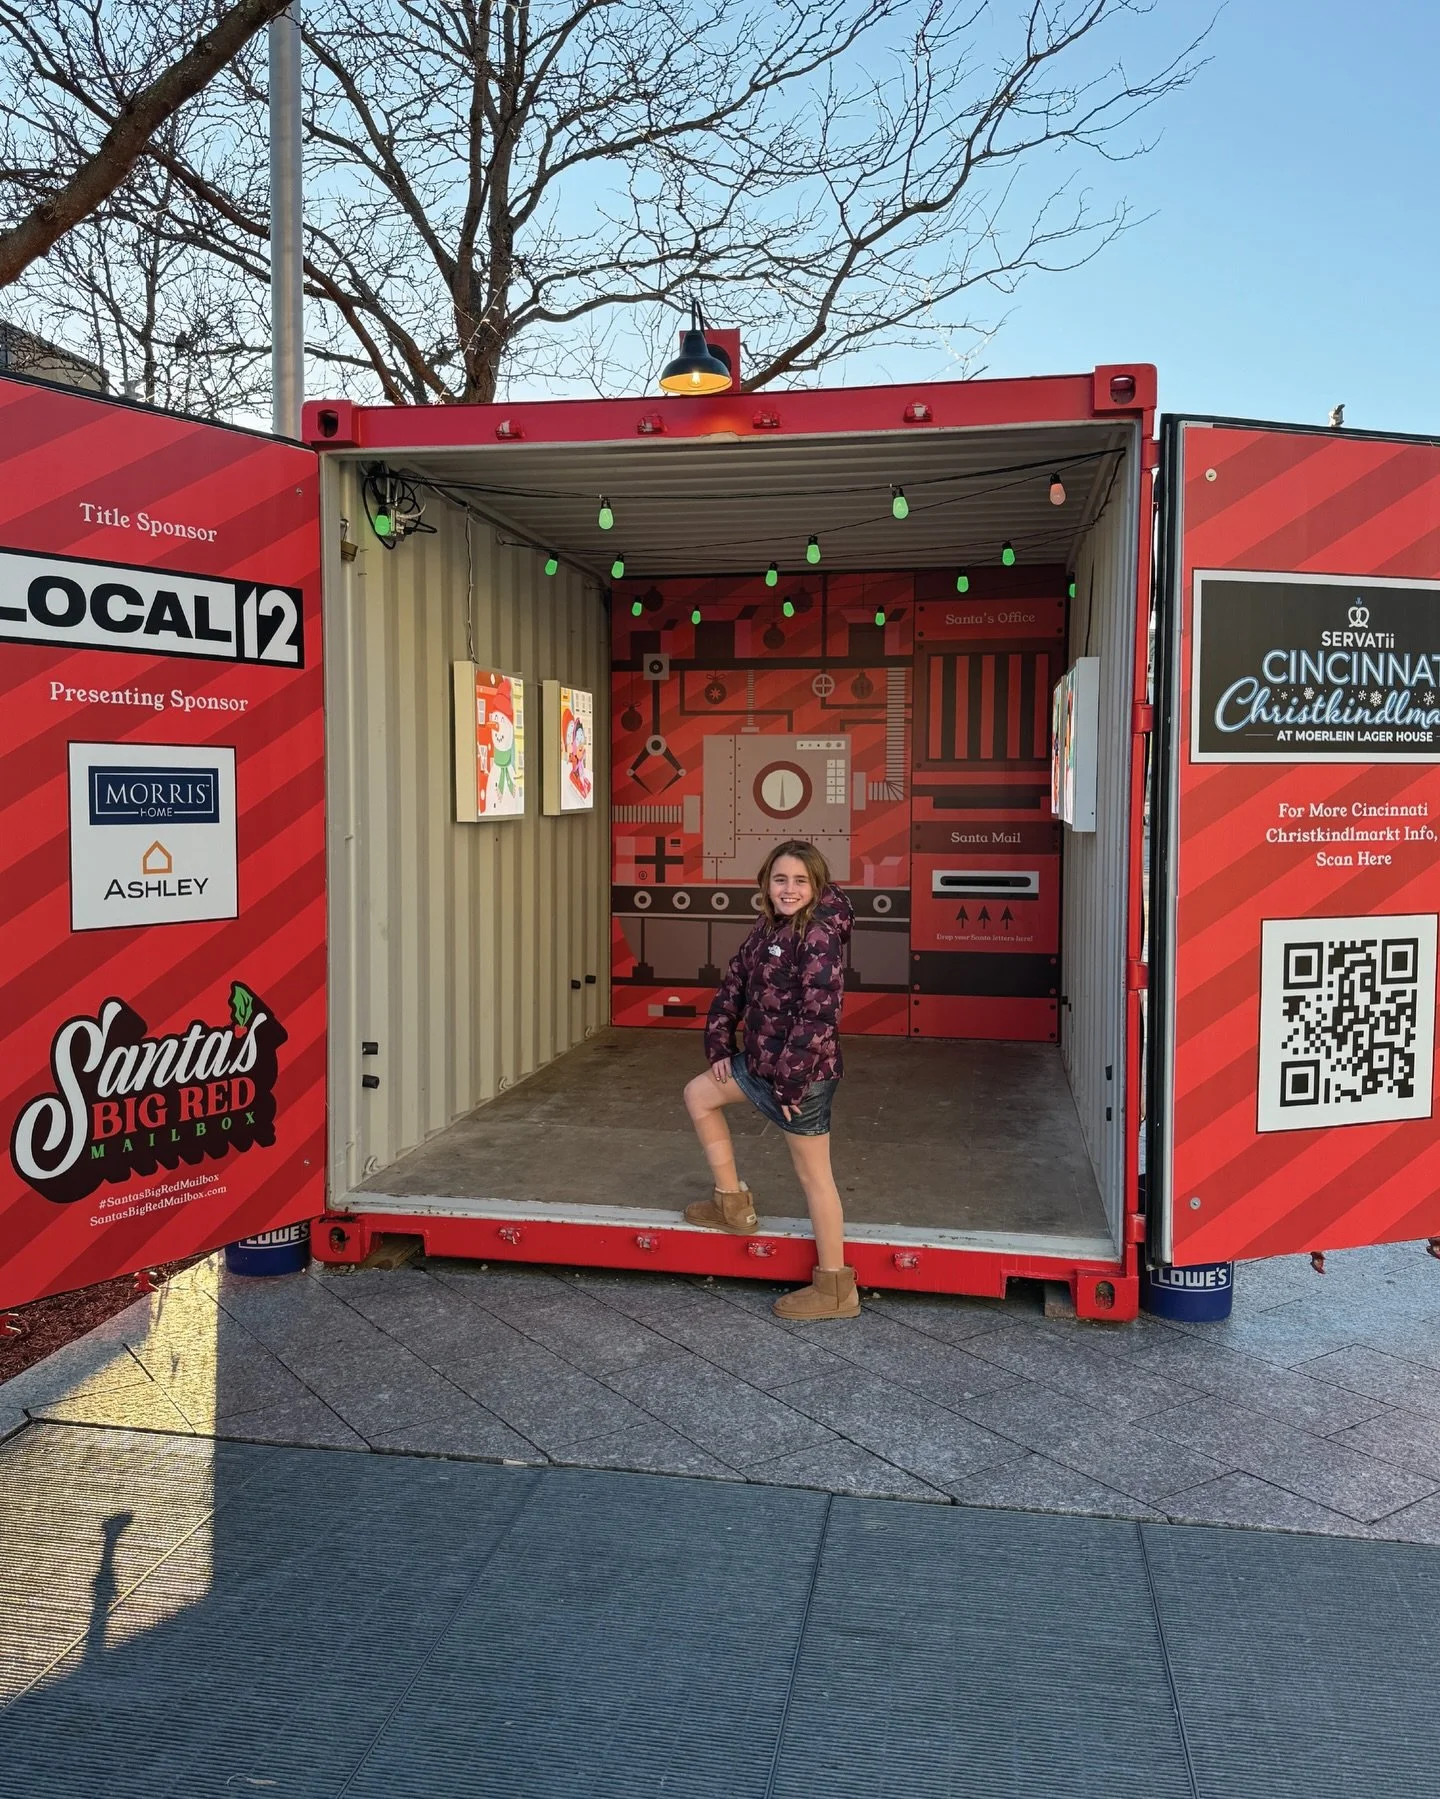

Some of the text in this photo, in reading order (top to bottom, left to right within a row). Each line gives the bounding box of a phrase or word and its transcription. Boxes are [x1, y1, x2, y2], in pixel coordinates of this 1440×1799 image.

[79, 502, 218, 542] Title Sponsor
[242, 586, 299, 663] 12
[945, 611, 1036, 626] Santa's Office
[1321, 631, 1395, 649] SERVATii
[50, 681, 249, 712] Presenting Sponsor
[1277, 730, 1434, 743] AT MOERLEIN LAGER HOUSE
[105, 783, 206, 805] MORRIS
[140, 807, 173, 818] HOME
[1278, 803, 1428, 817] For More Cincinnati
[951, 831, 1021, 844] Santa Mail
[1266, 826, 1438, 843] Christkindlmarkt Info,
[1316, 852, 1392, 867] Scan Here
[104, 878, 209, 900] ASHLEY
[91, 1076, 257, 1141] BIG RED
[91, 1110, 256, 1160] MAILBOX
[98, 1173, 220, 1210] #SantasBigRedMailbox
[89, 1185, 228, 1227] SantasBigRedMailbox.com
[1158, 1267, 1228, 1287] LOWE'S
